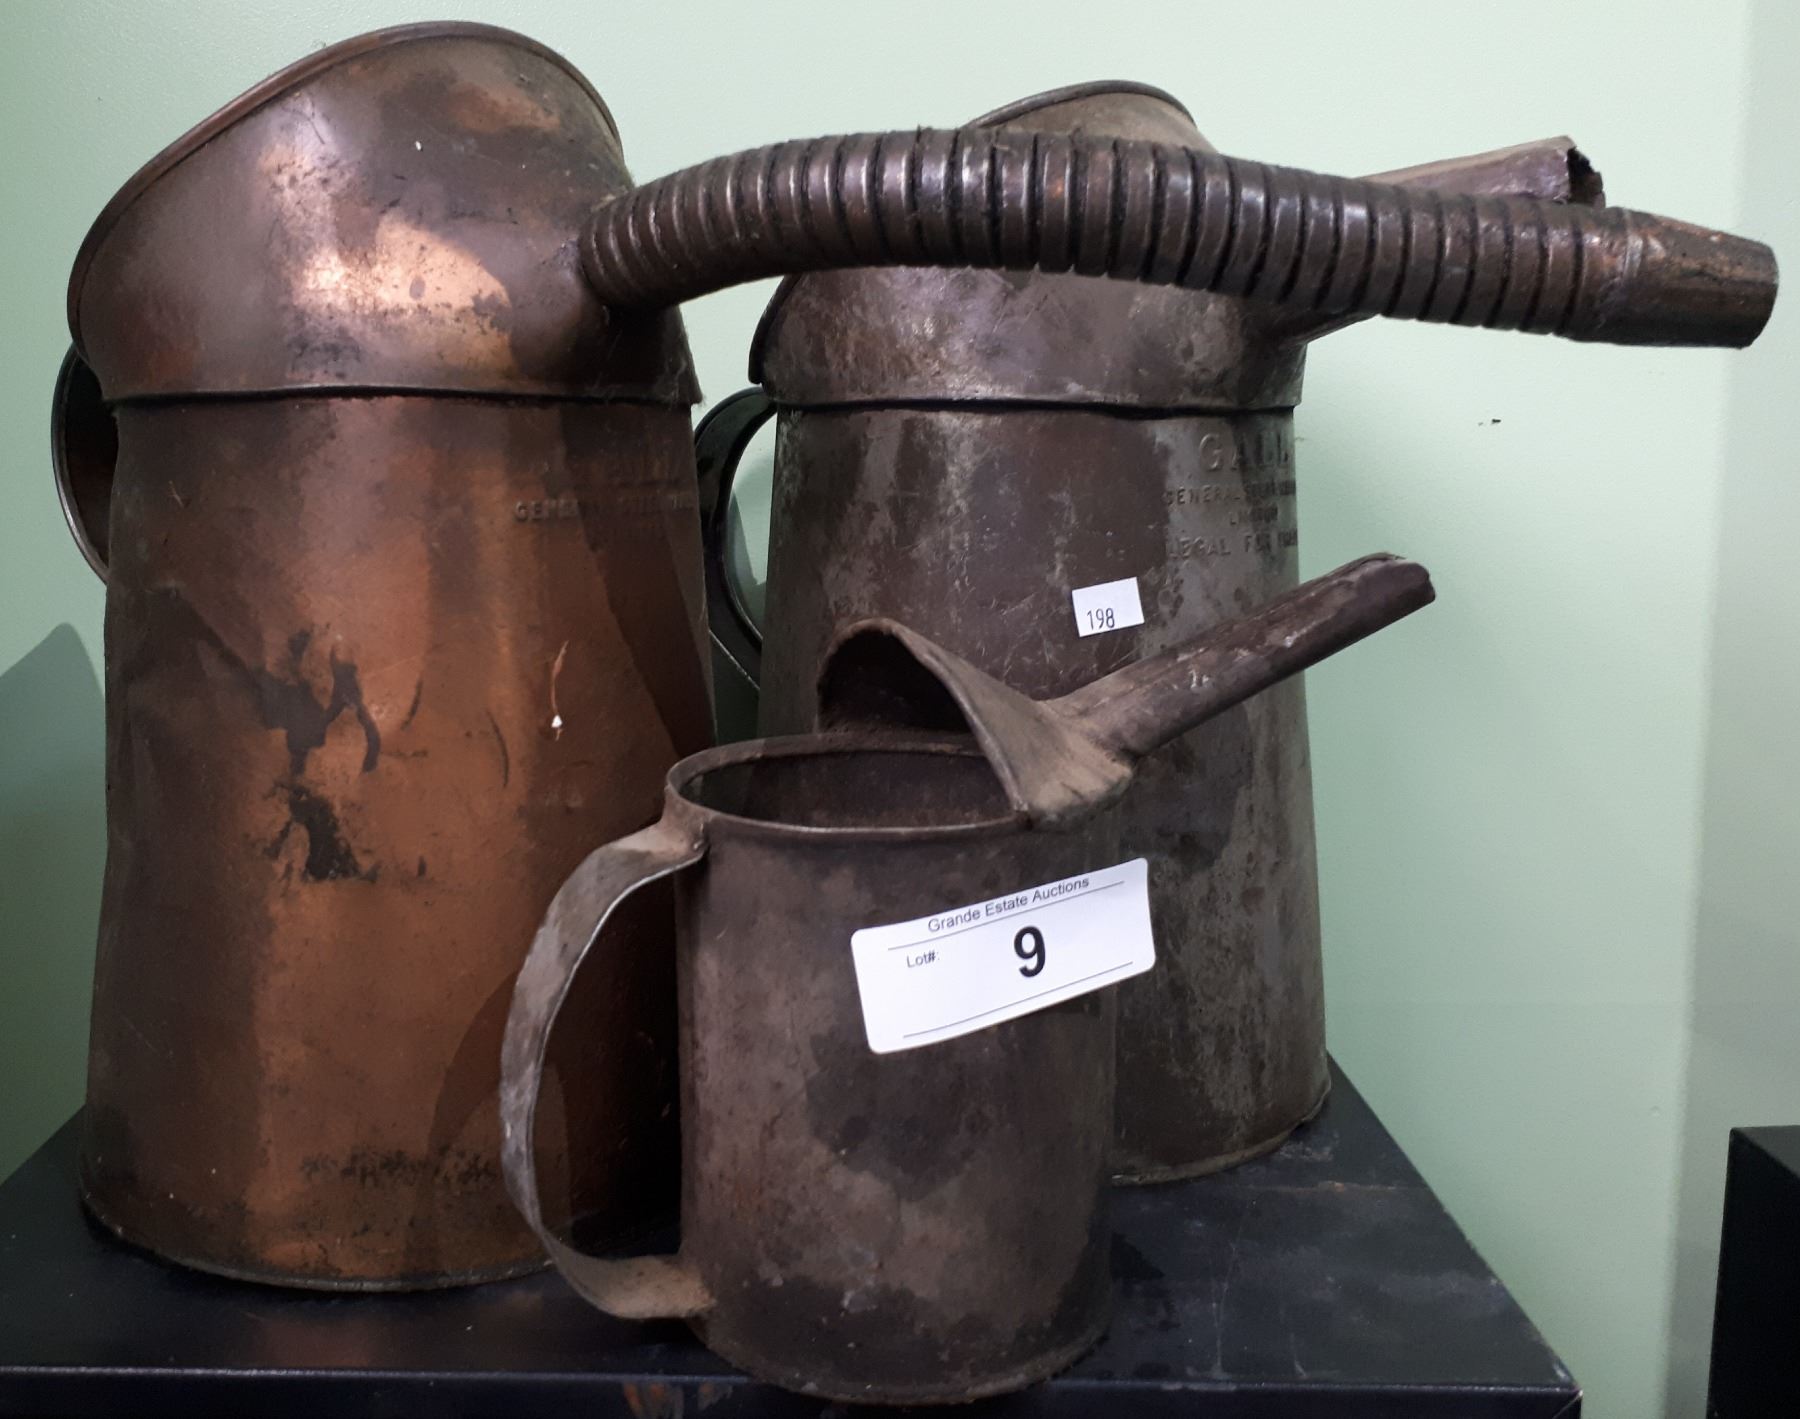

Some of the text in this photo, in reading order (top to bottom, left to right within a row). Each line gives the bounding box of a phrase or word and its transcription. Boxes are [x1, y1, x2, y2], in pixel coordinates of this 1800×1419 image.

[1086, 607, 1115, 630] 198
[928, 877, 1089, 933] Grande Estate Auctions
[906, 949, 940, 968] Lot#:
[1013, 925, 1046, 978] 9
